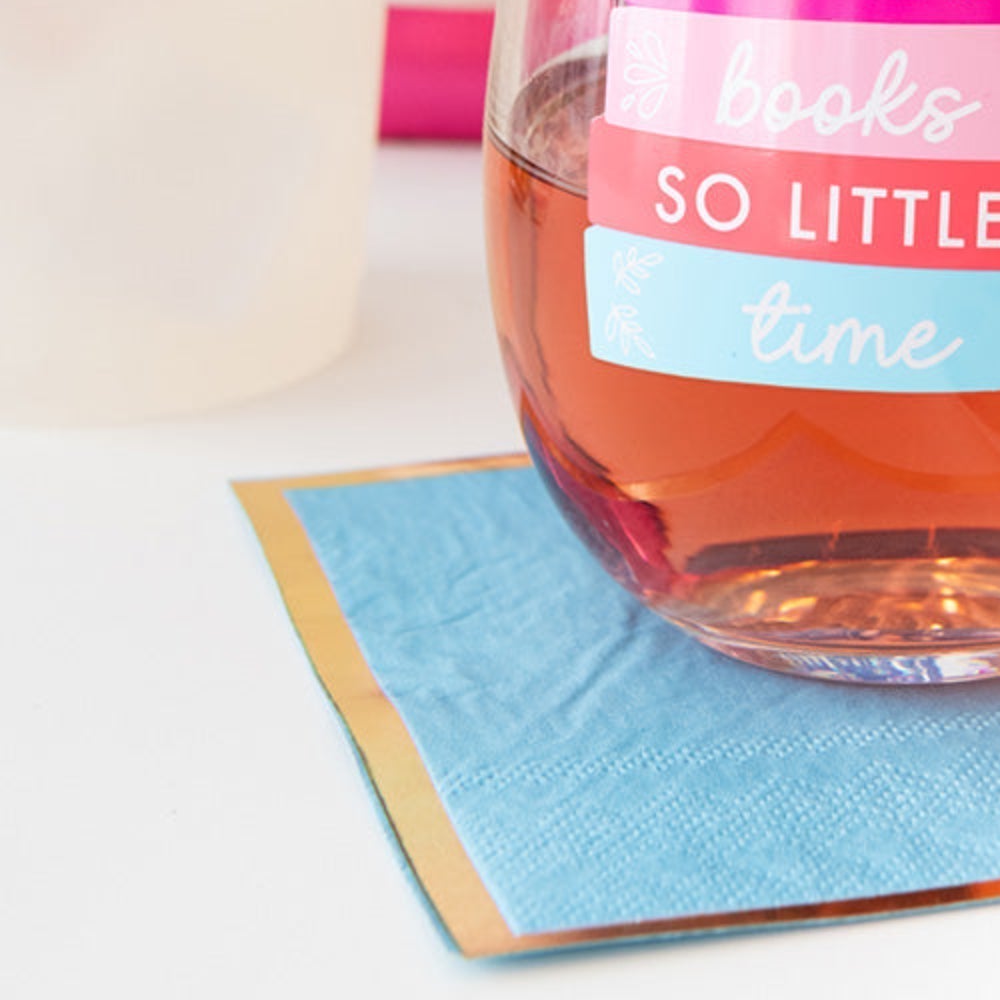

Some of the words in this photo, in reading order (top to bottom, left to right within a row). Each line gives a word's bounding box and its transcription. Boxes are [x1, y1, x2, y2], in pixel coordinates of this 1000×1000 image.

[715, 41, 981, 142] books
[654, 165, 751, 231] SO
[742, 281, 963, 370] time
